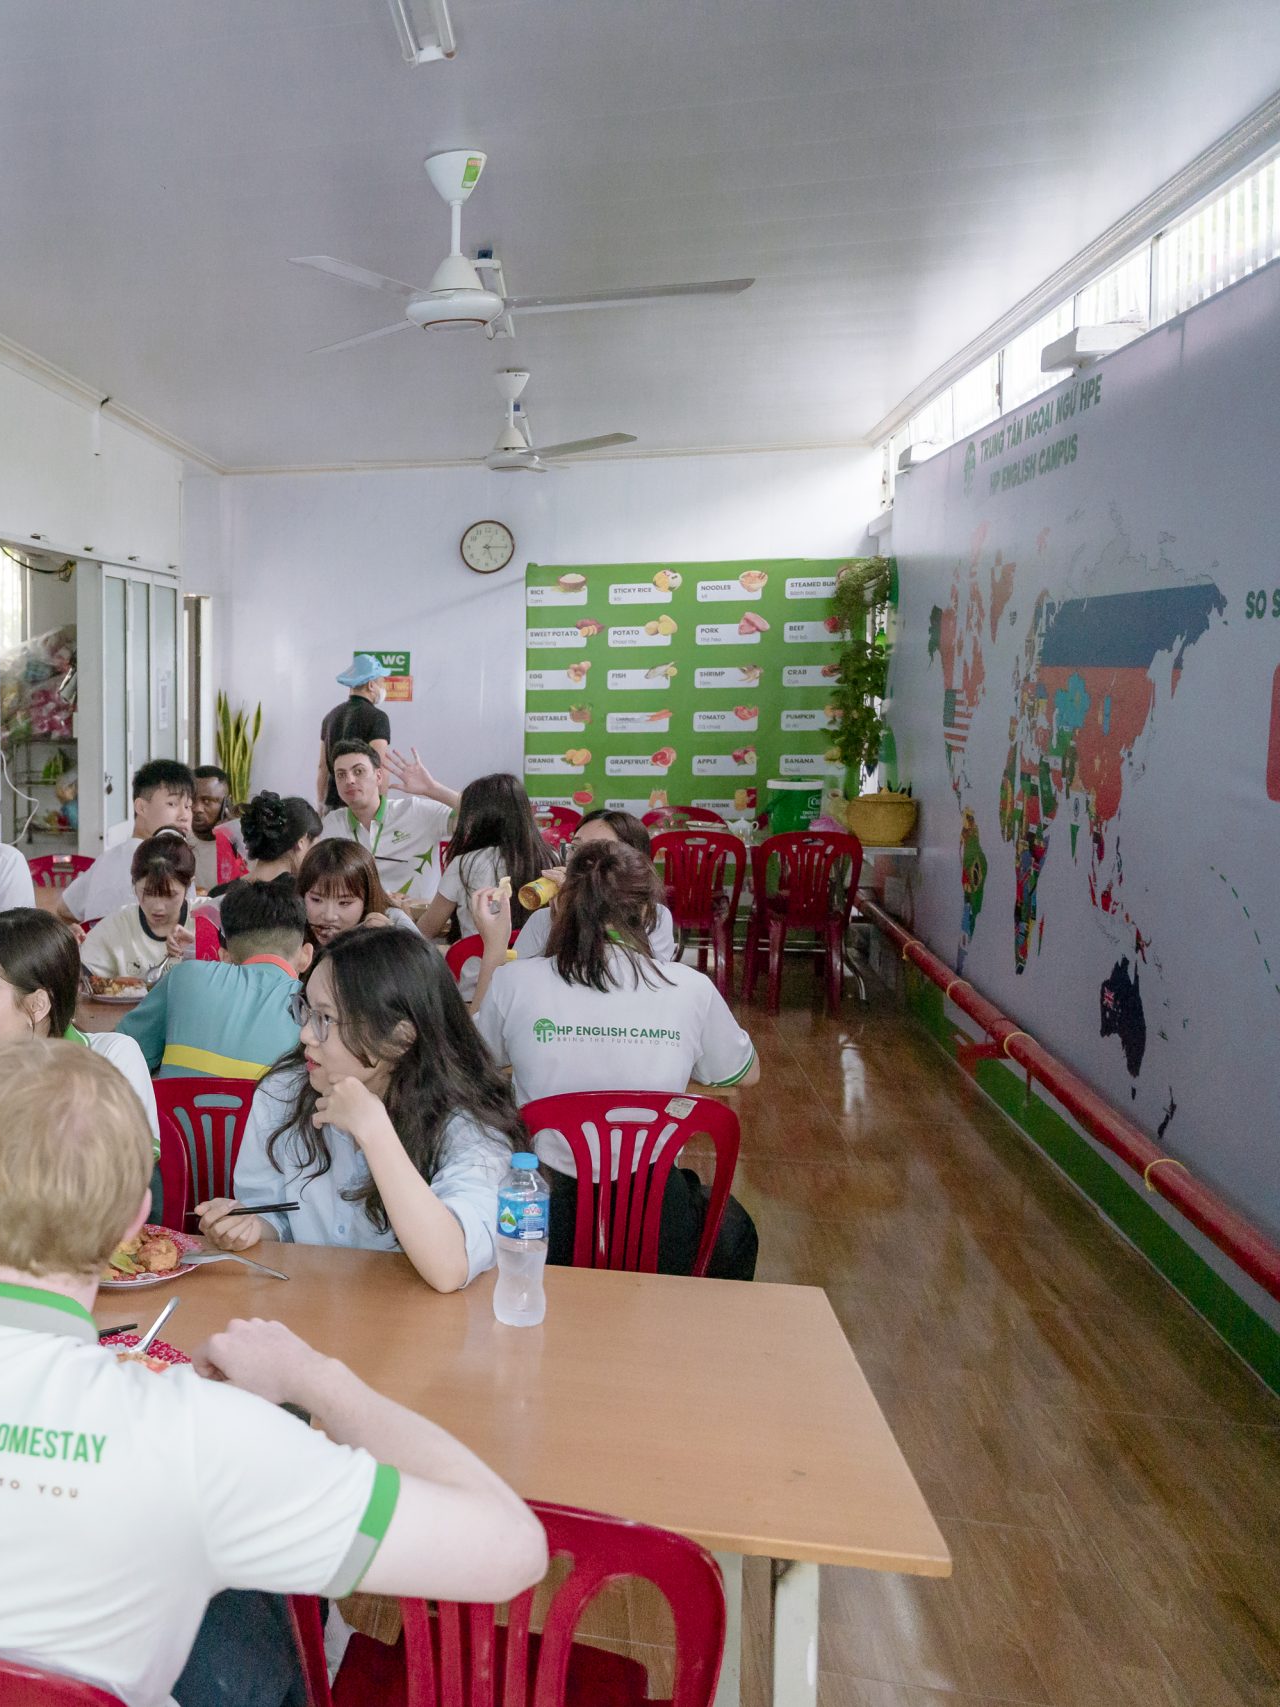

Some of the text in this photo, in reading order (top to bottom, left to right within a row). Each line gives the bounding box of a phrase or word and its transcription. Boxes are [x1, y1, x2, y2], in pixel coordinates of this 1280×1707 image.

[1080, 373, 1102, 412] HPE
[1001, 433, 1078, 492] ENGLISH CAMPUS
[382, 655, 405, 665] WC
[557, 1025, 681, 1041] HP ENGLISH CAMPUS
[0, 1476, 21, 1491] TO
[38, 1484, 80, 1500] YOU
